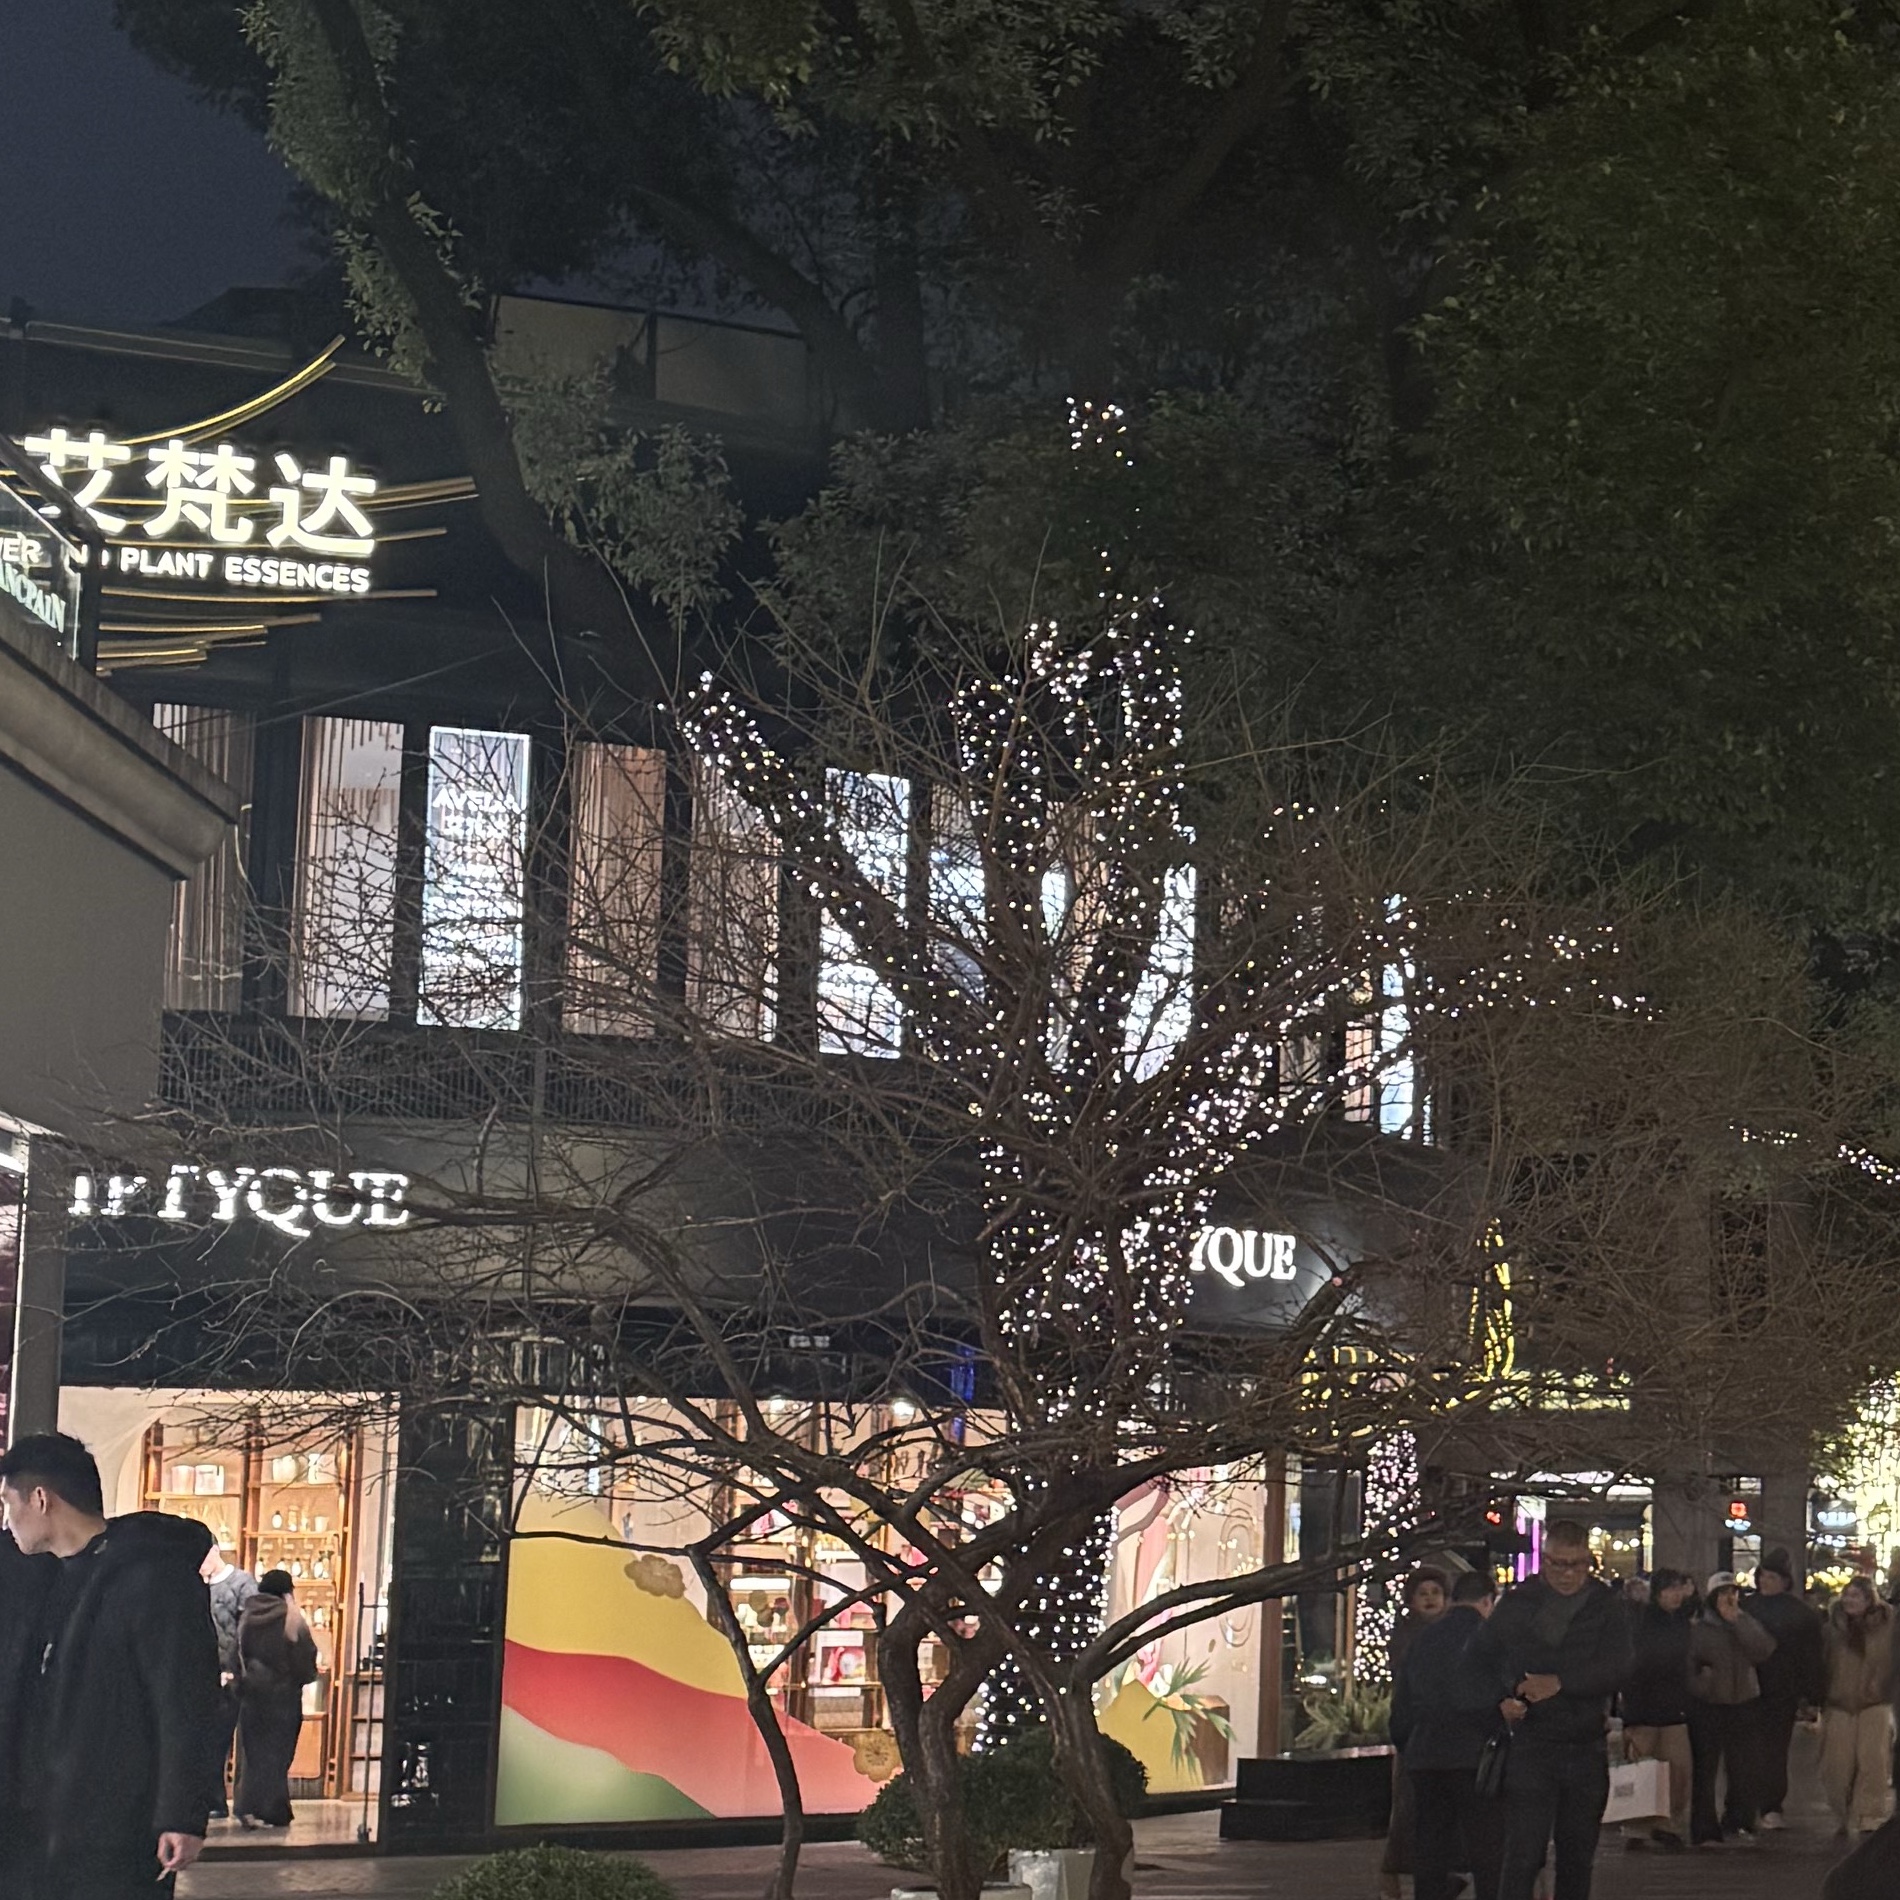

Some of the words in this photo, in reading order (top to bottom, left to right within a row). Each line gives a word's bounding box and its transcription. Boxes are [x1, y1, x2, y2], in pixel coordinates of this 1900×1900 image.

[23, 426, 377, 556] 艾梵达
[0, 536, 41, 563] ER
[120, 546, 214, 580] PLANT
[224, 557, 371, 593] ESSENCES
[67, 1164, 409, 1238] IPTYQUE
[1188, 1225, 1297, 1288] YQUE
